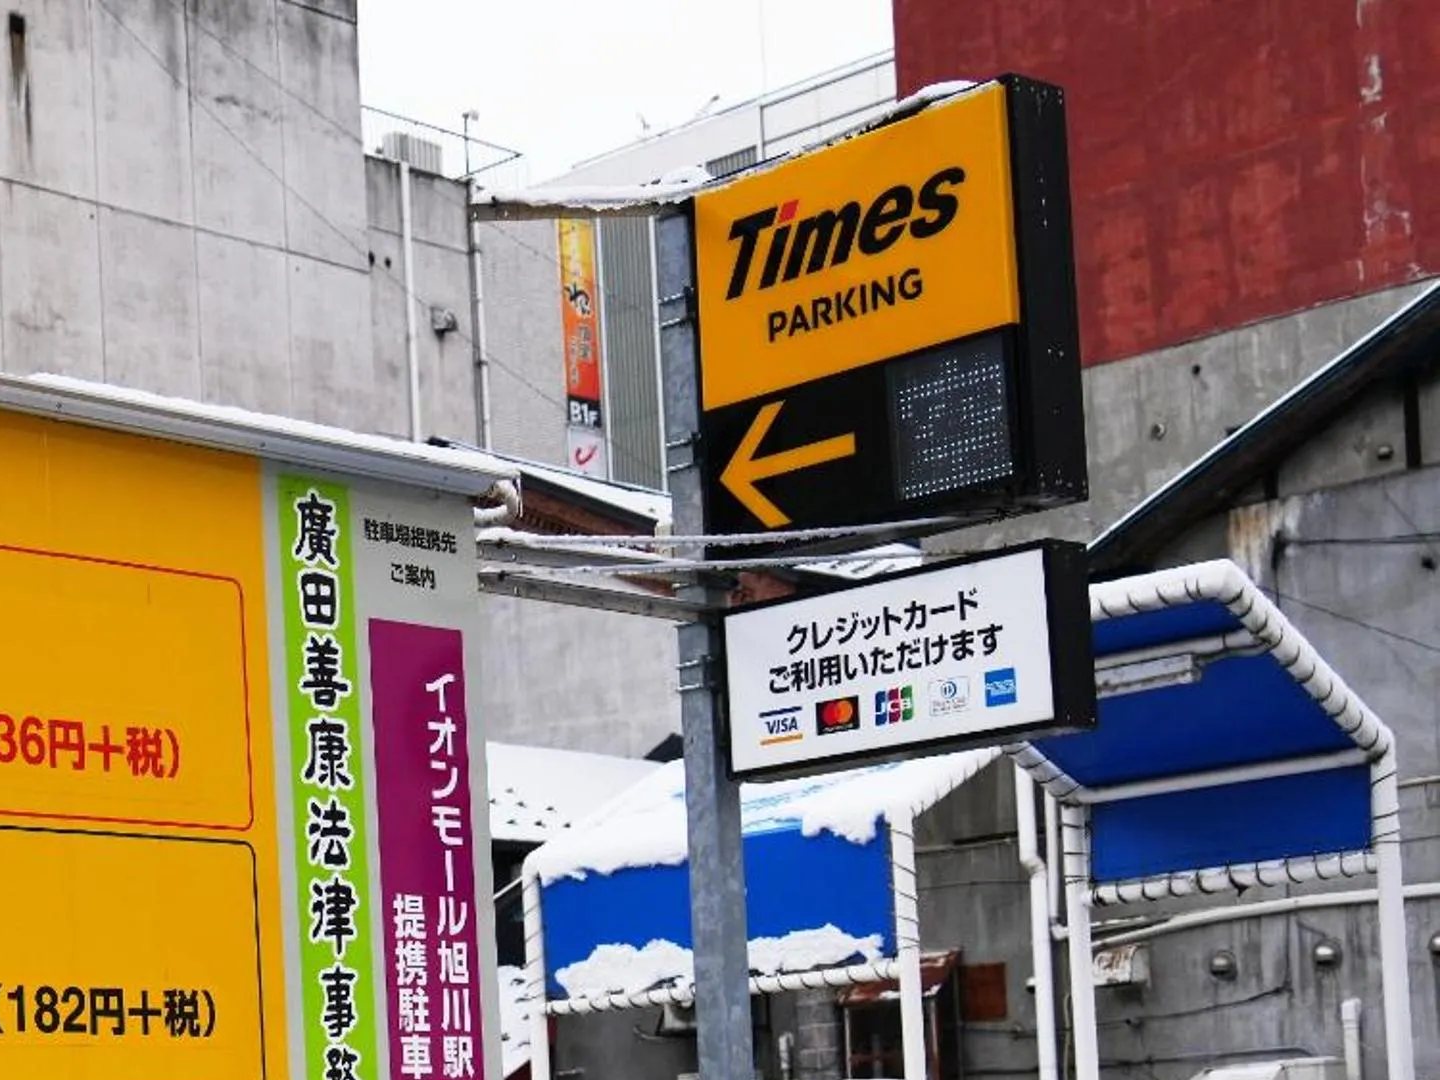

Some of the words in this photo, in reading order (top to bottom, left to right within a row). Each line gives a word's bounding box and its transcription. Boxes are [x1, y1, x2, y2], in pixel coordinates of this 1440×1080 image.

[725, 166, 966, 301] Times
[767, 267, 924, 343] PARKING
[363, 518, 457, 554] 駐車場提携先
[390, 562, 436, 590] ご案内
[786, 587, 979, 655] クレジットカード
[768, 623, 1004, 695] ご利用いただけます
[765, 716, 799, 735] VISA
